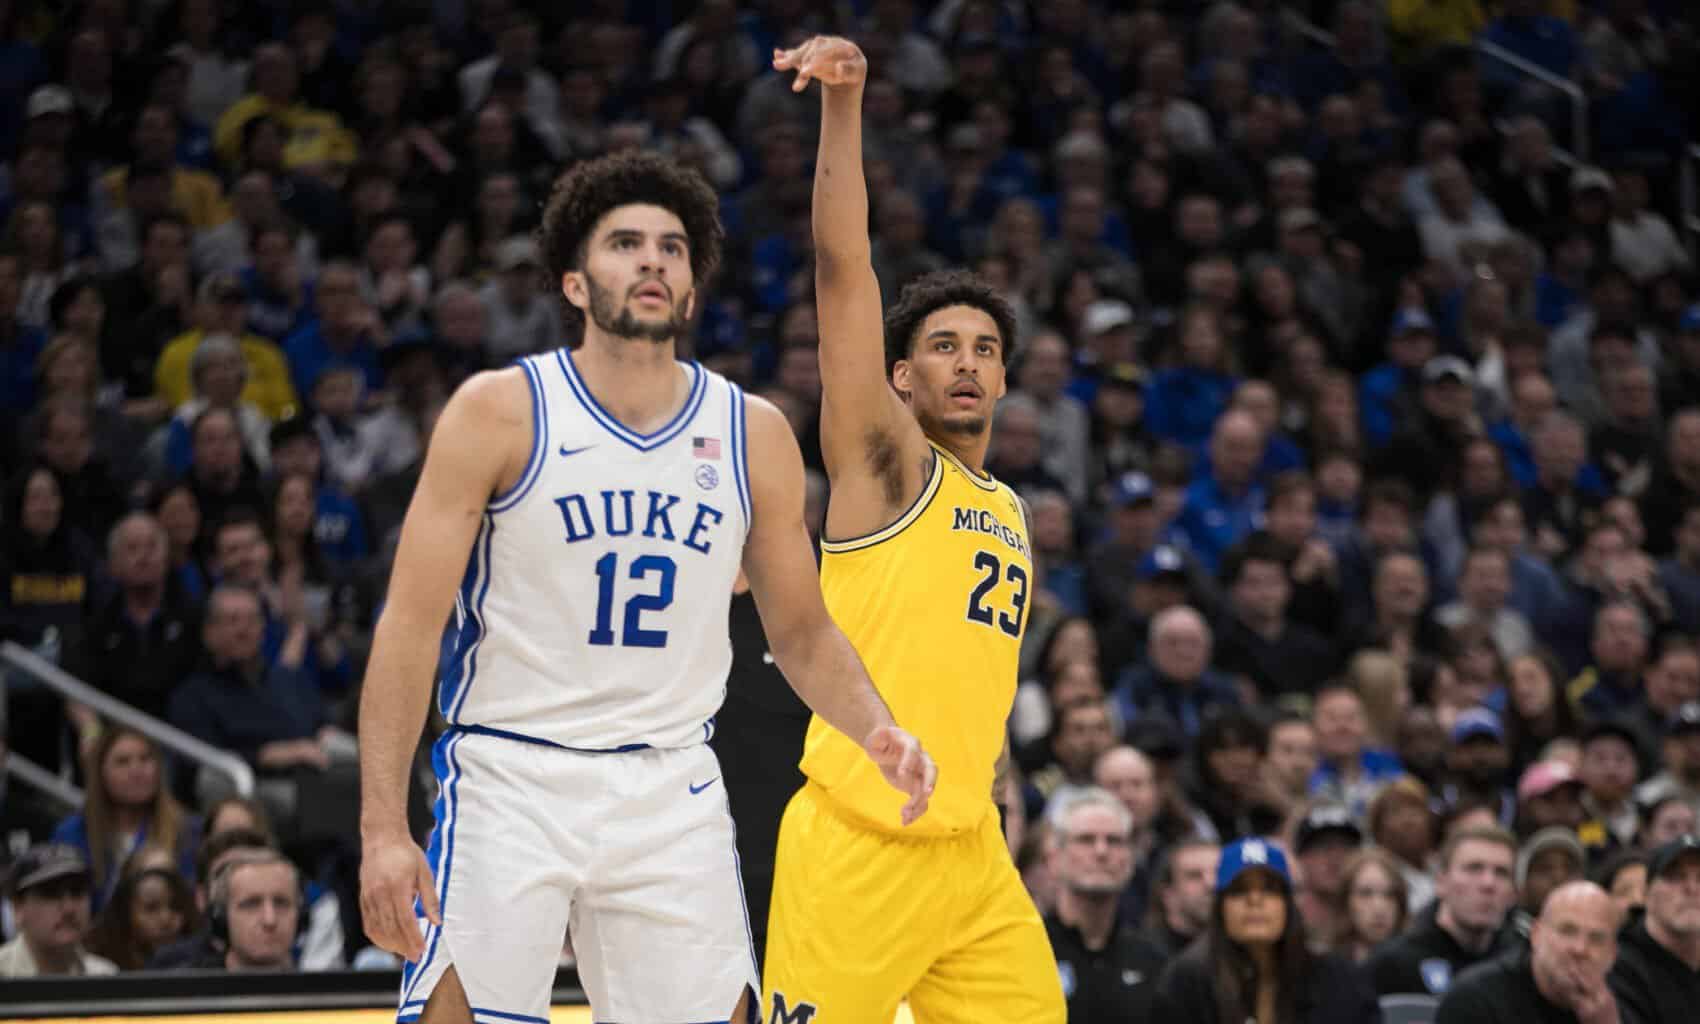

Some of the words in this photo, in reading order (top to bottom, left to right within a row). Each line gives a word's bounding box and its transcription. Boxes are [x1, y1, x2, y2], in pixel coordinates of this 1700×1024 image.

[554, 490, 723, 555] DUKE
[588, 552, 677, 648] 12
[967, 550, 1028, 639] 23
[769, 991, 817, 1024] M
